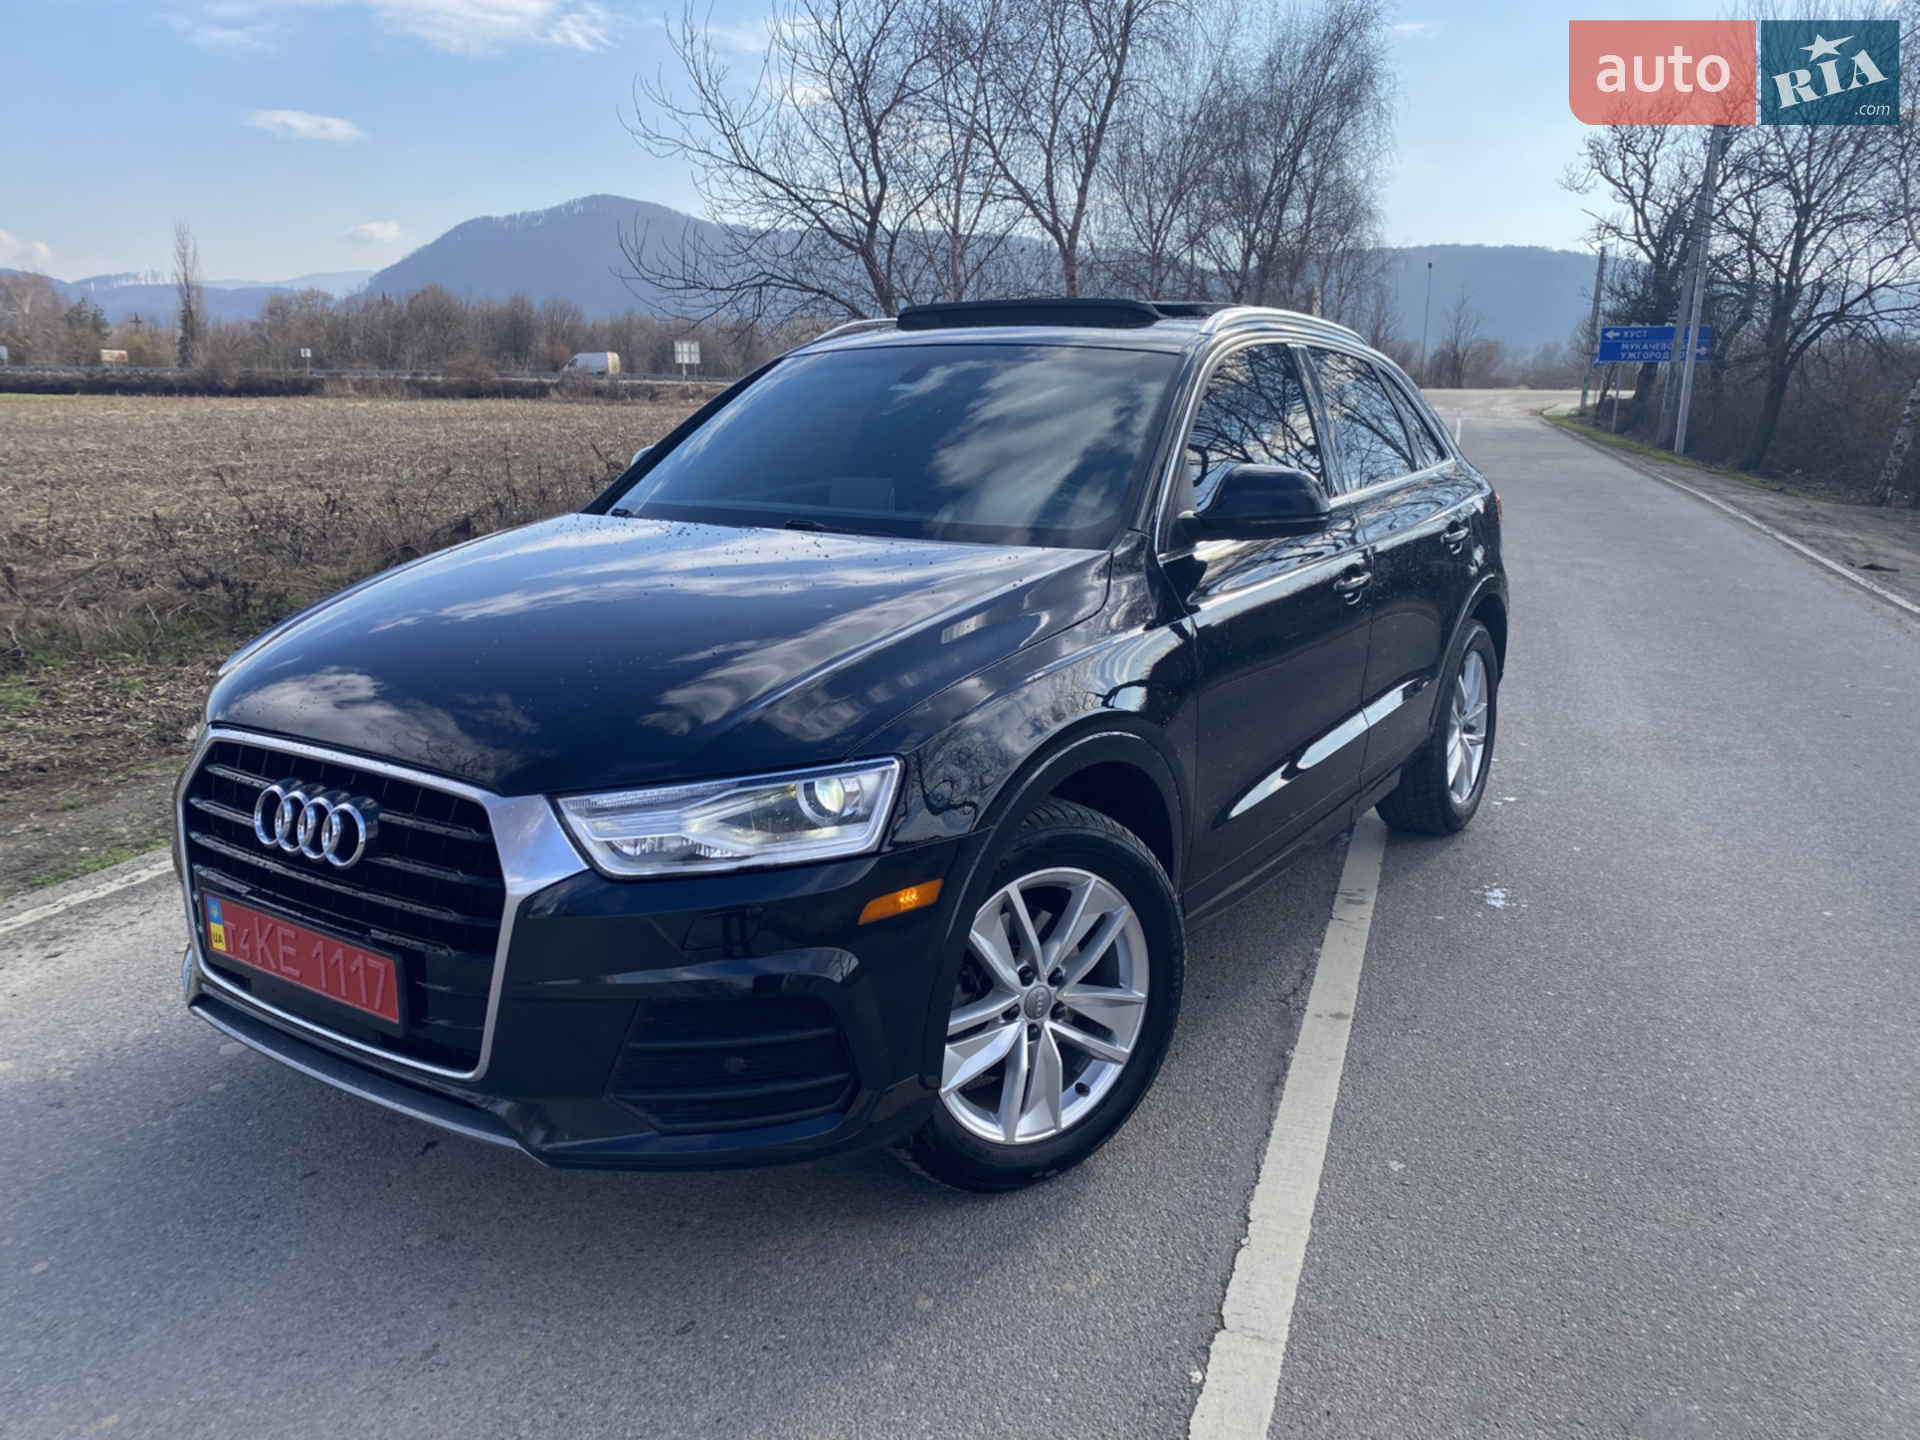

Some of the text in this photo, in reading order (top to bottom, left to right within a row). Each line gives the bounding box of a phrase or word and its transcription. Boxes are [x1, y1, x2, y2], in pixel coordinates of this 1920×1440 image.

[1622, 330, 1648, 339] ХУСТ
[1620, 343, 1674, 351] МУКАЧЕВО
[1620, 351, 1670, 360] УЖГОРОД
[213, 932, 224, 945] UA
[311, 940, 386, 1010] 1117
